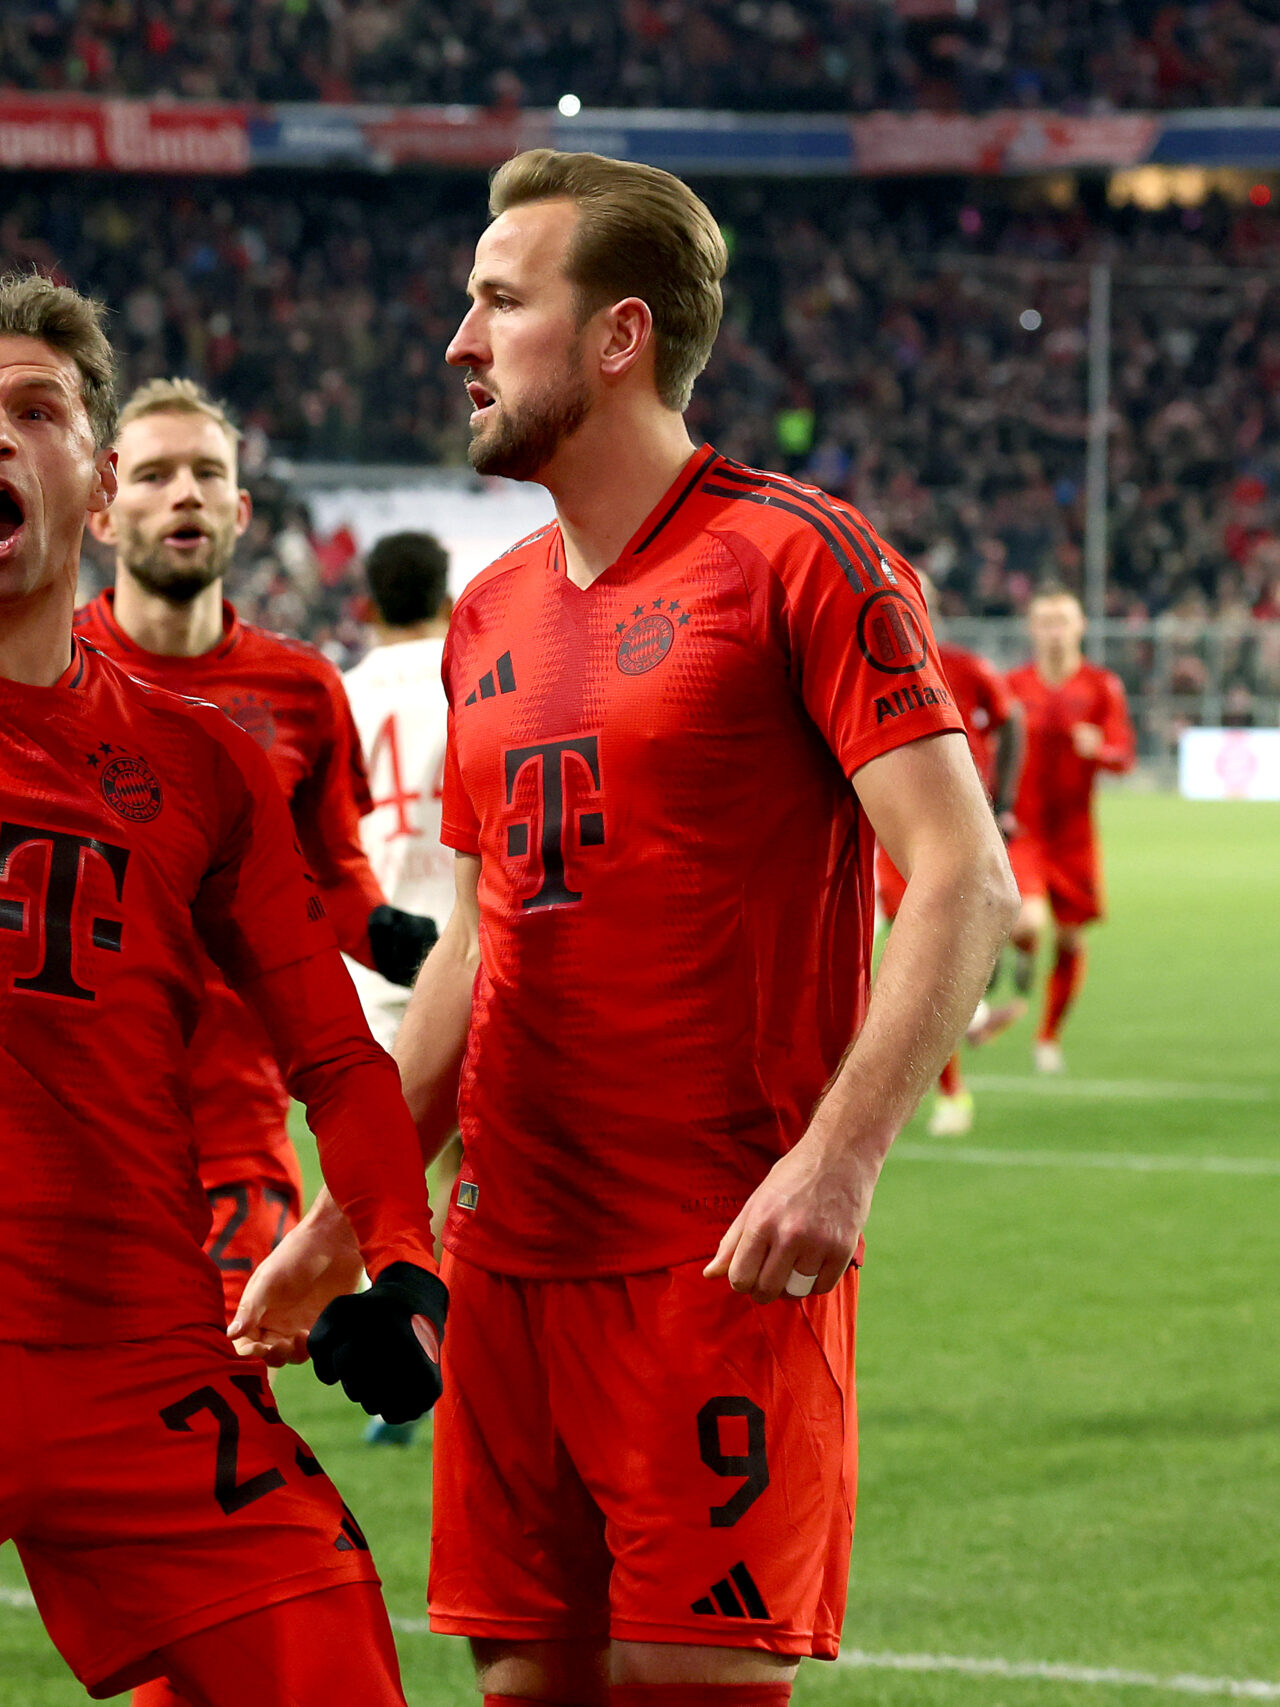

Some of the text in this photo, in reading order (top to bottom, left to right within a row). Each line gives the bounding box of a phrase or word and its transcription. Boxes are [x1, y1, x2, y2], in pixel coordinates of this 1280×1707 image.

[116, 760, 161, 789] BAYERN
[506, 735, 605, 909] T
[206, 1186, 291, 1271] 27
[697, 1395, 770, 1528] 9
